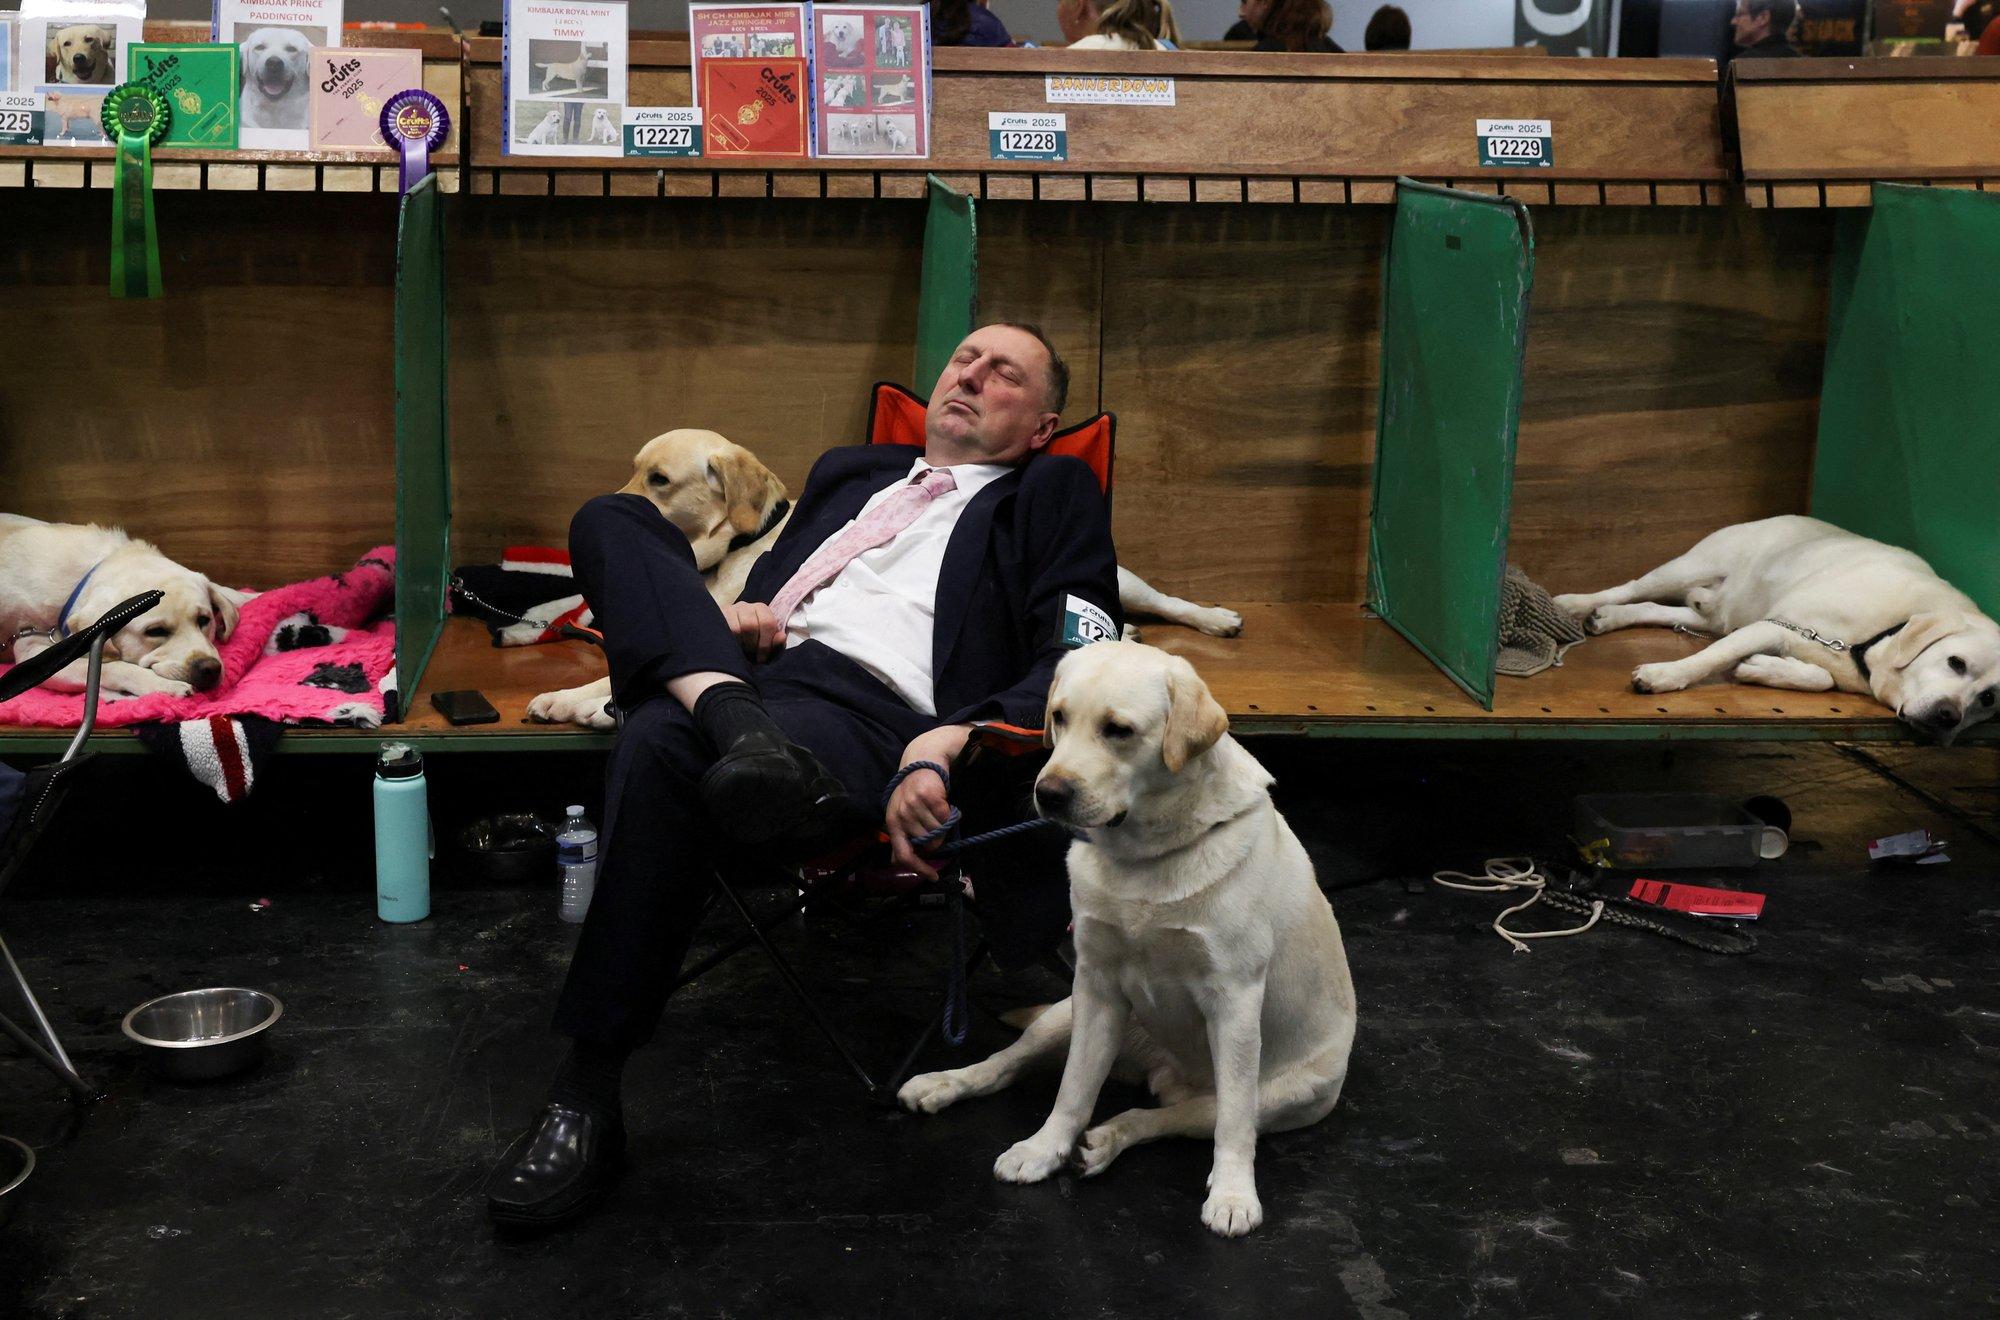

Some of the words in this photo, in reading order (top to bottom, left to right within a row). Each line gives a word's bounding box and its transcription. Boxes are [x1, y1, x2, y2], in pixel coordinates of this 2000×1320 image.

[290, 0, 323, 8] PRINCE
[566, 8, 589, 16] ROYAL
[249, 11, 313, 21] PADDINGTON
[553, 28, 585, 37] TIMMY
[321, 58, 361, 93] Crufts
[341, 78, 364, 99] 2025
[761, 67, 797, 103] Crufts
[1051, 76, 1169, 93] BANNERDOWN
[6, 97, 35, 106] 2025
[756, 86, 777, 106] 2025
[667, 112, 693, 121] 2025
[1006, 117, 1028, 125] Crufts
[1032, 118, 1057, 127] 2025
[636, 128, 690, 145] 12227
[1518, 124, 1543, 133] 2025
[1003, 133, 1054, 150] 12228
[1490, 140, 1540, 156] 12229
[1081, 621, 1111, 641] 12
